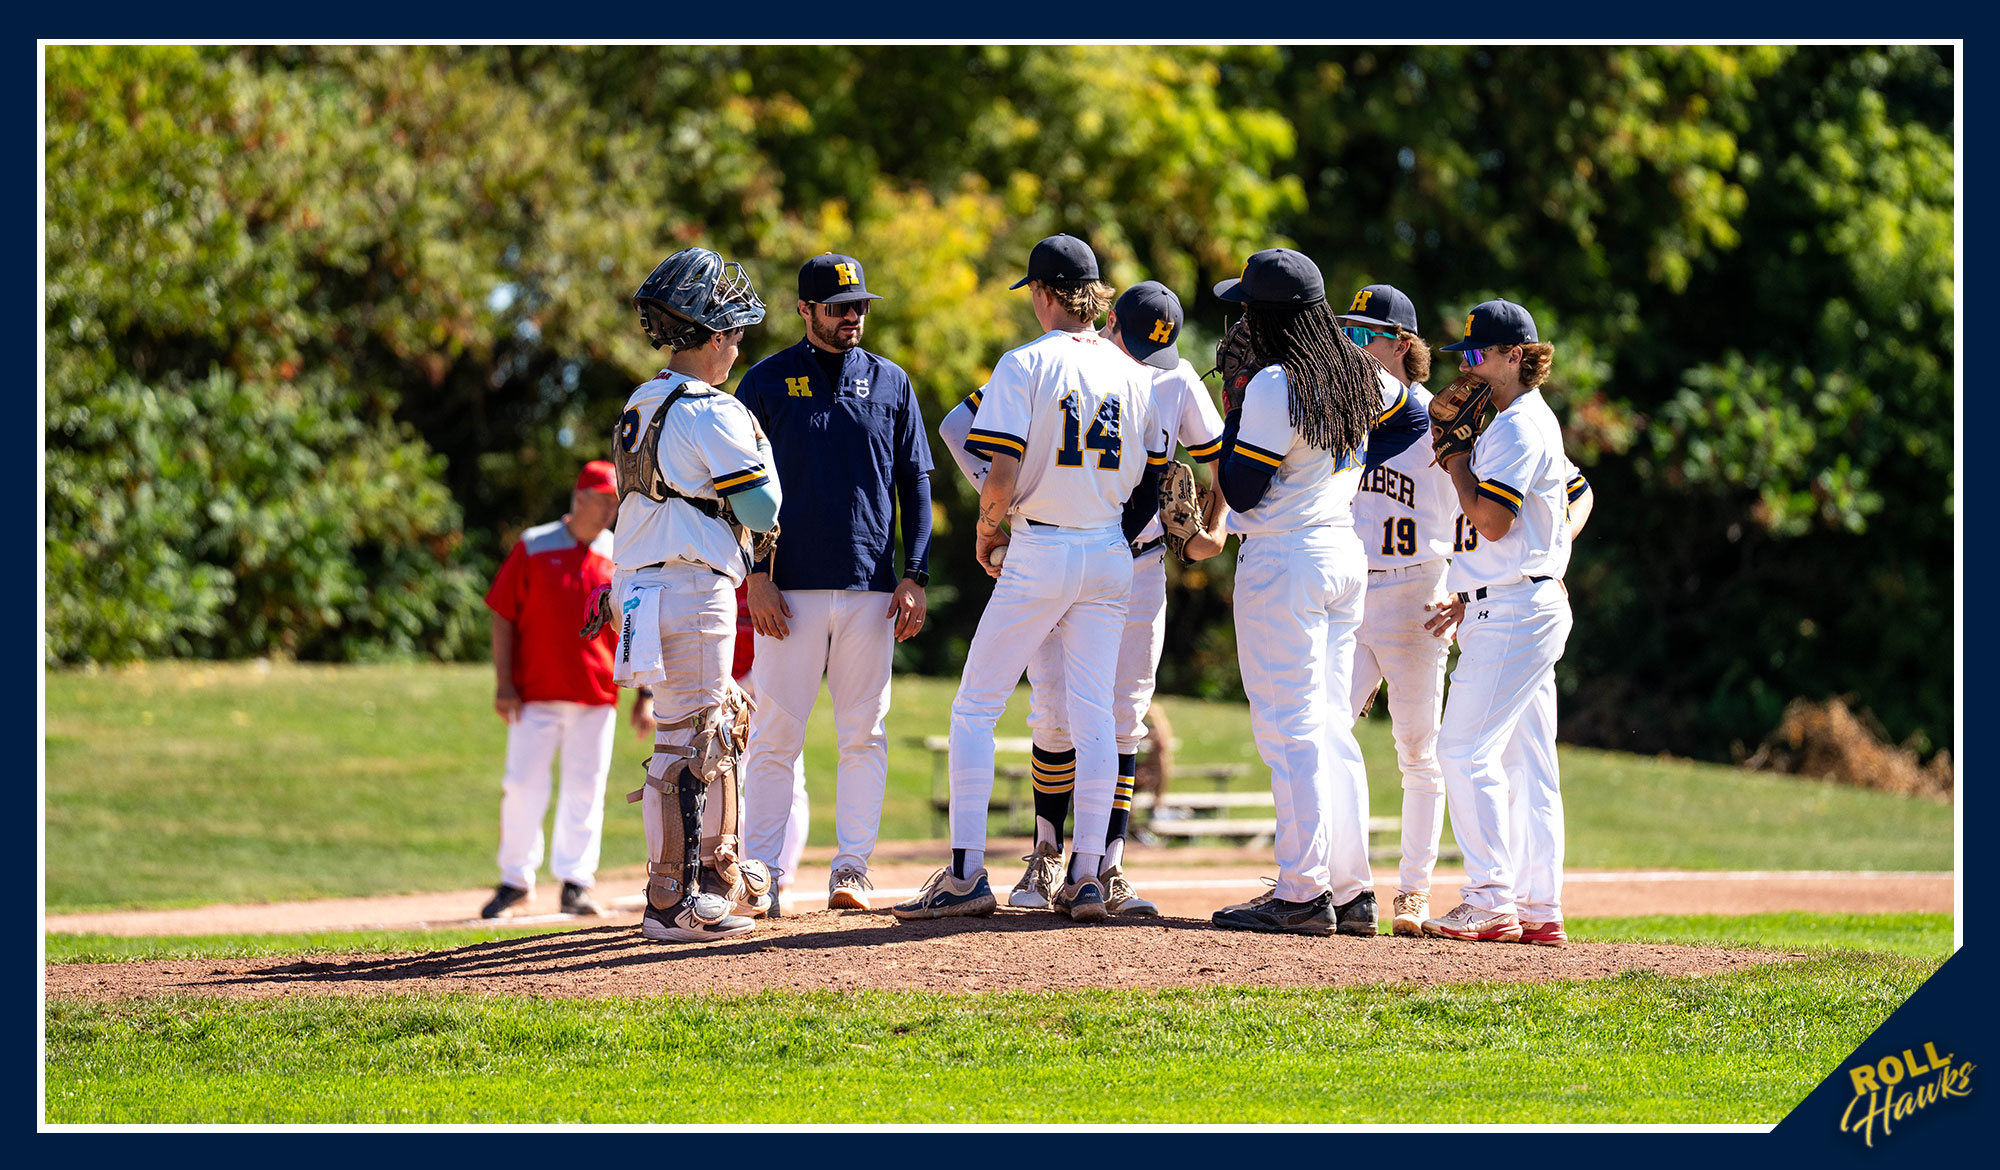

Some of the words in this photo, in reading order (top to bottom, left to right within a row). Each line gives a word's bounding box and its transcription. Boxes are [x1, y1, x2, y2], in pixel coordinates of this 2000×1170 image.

[834, 262, 860, 286] H
[1349, 290, 1373, 311] H
[1148, 319, 1175, 344] H
[785, 376, 813, 397] H
[1056, 389, 1123, 471] 14
[1381, 516, 1418, 557] 19
[1453, 513, 1479, 553] 13
